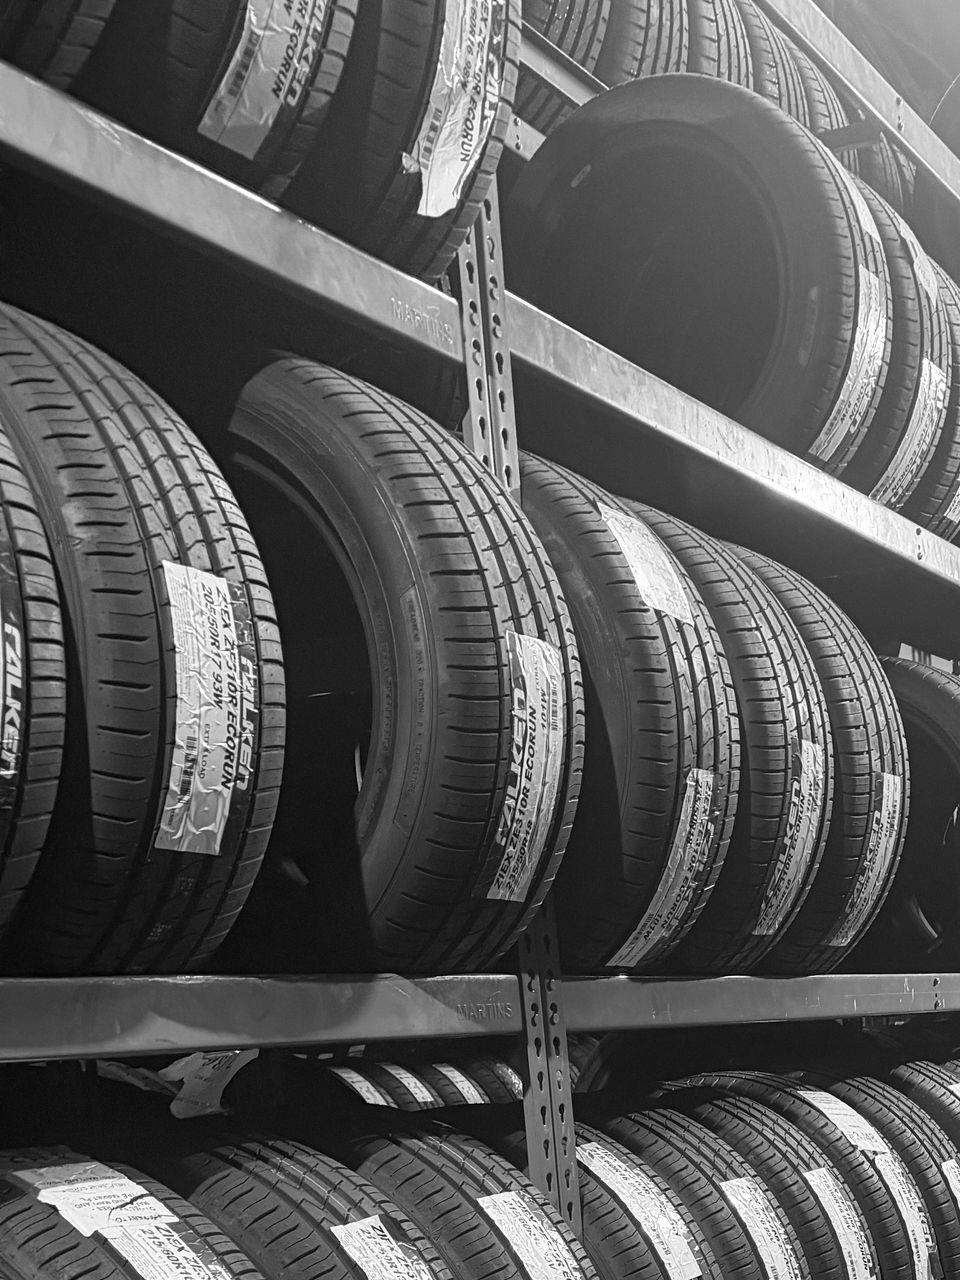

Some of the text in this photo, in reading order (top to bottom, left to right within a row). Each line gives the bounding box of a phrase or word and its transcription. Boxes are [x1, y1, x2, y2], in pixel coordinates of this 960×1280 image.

[271, 20, 303, 99] ECORUN
[461, 99, 478, 162] ECORUN
[211, 672, 223, 710] 93W
[235, 655, 260, 791] FALKEN
[221, 709, 240, 791] ECORUN
[495, 687, 526, 847] FALKEN
[494, 704, 538, 890] ZIEX ZE310R ECORUN
[789, 794, 806, 851] ECORUN
[766, 780, 802, 897] FALKEN
[643, 912, 663, 941] 101W
[661, 874, 690, 930] ECORUN
